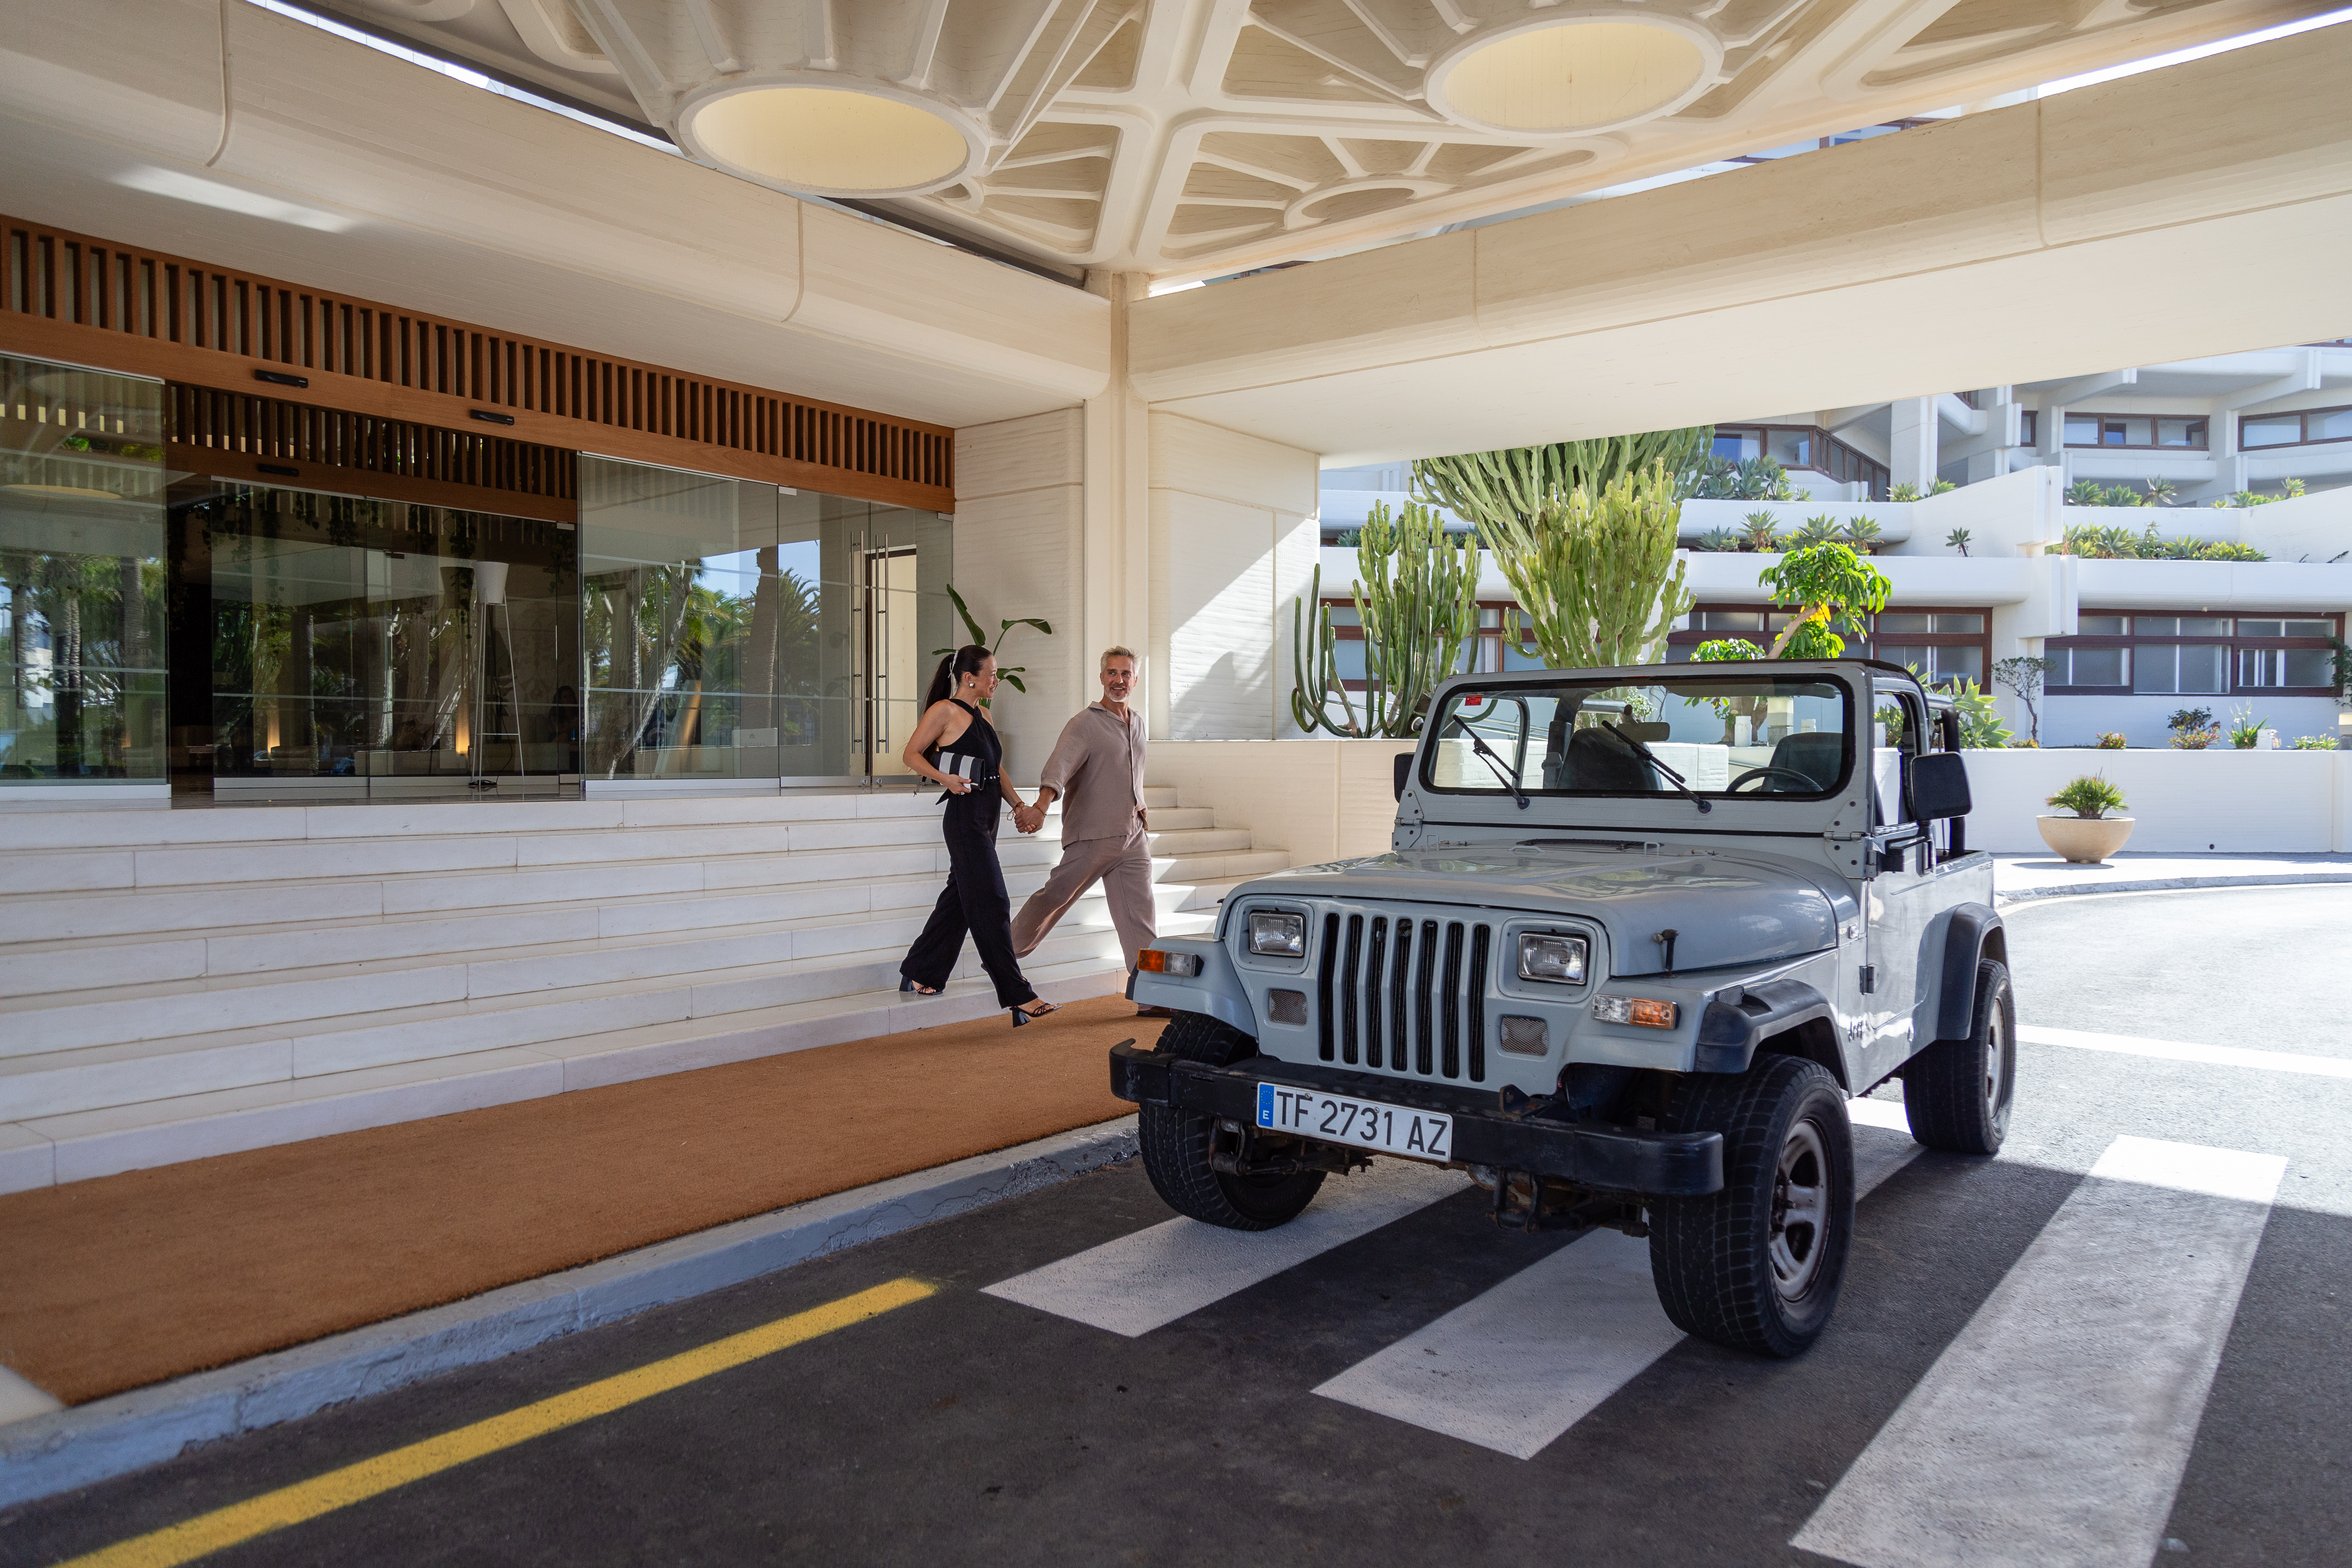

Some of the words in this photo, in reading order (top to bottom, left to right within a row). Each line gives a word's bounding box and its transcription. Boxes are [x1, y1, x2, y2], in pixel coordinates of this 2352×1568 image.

[1263, 1110, 1269, 1120] E
[1277, 1091, 1313, 1127] TF
[1320, 1100, 1393, 1145] 2731
[1407, 1116, 1448, 1156] AZ
